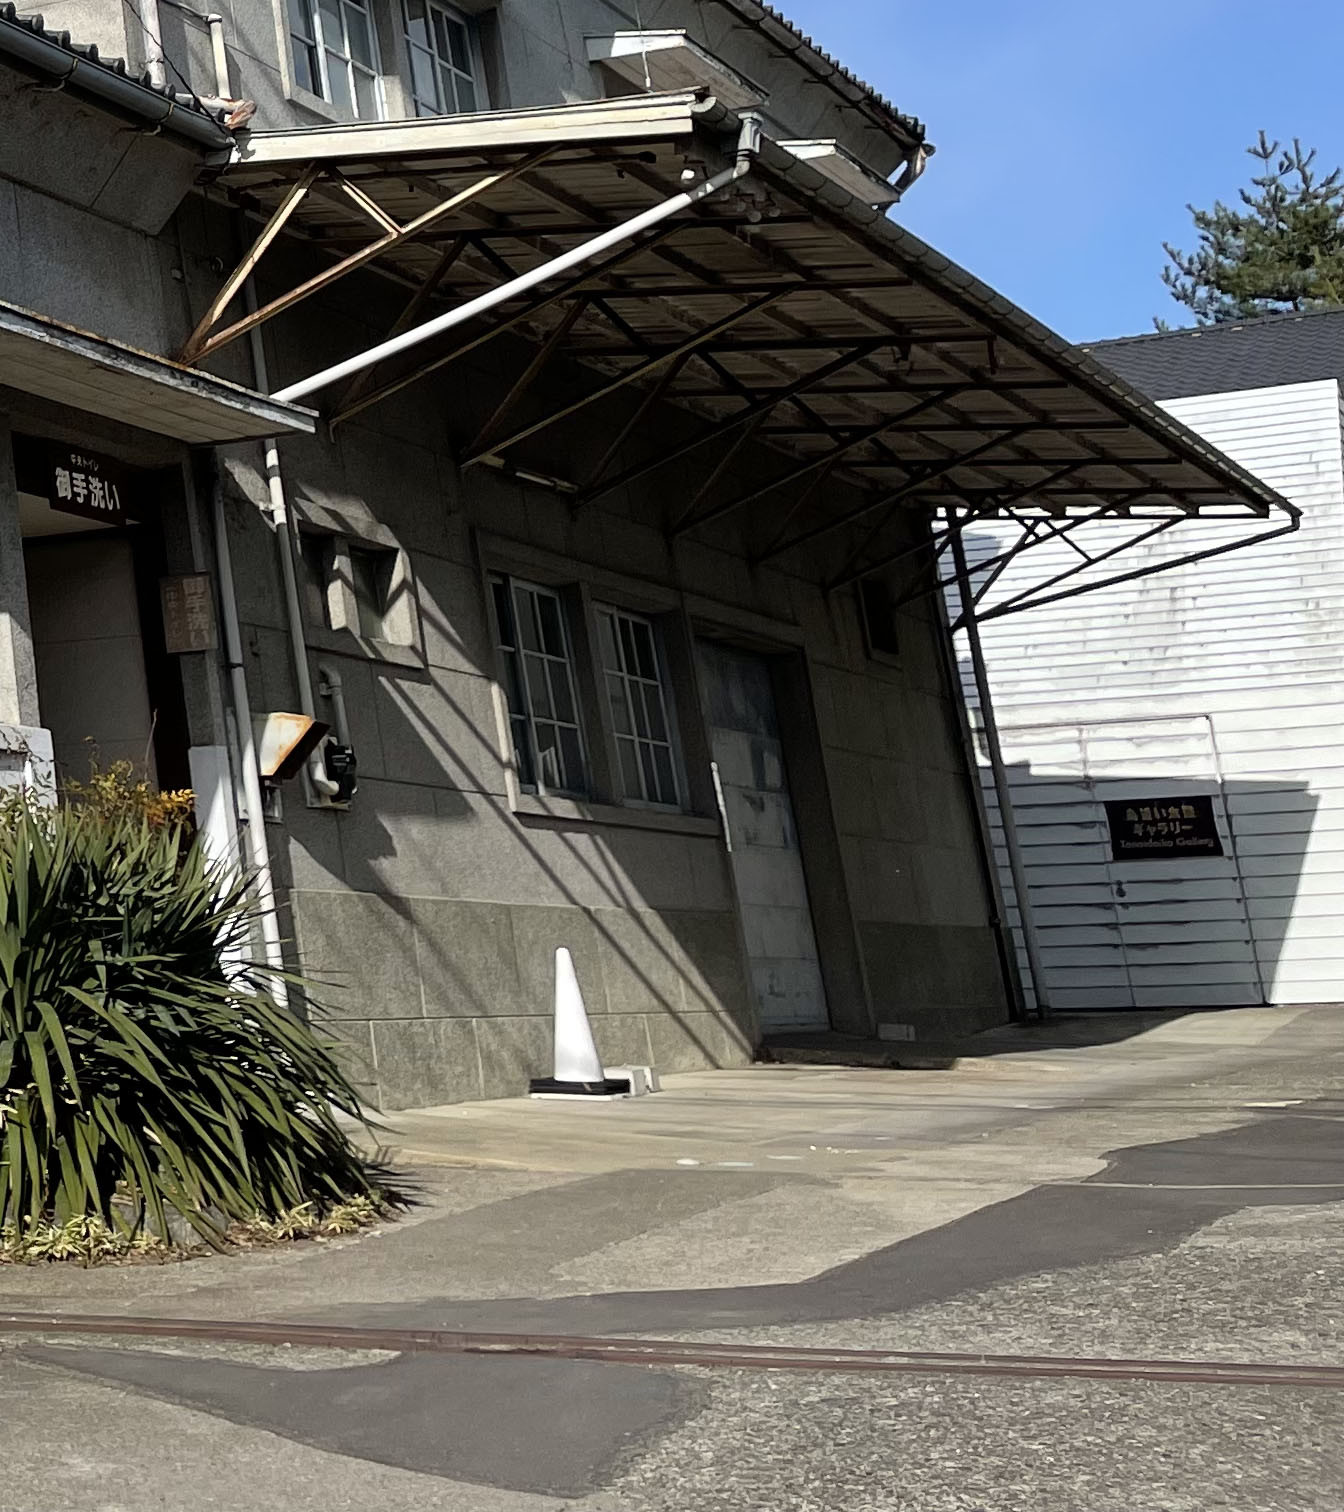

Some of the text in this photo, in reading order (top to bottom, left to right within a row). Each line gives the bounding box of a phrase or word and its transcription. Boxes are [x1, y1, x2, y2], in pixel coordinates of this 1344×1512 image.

[55, 467, 120, 510] 御手洗い
[1133, 821, 1194, 836] ギャラリー
